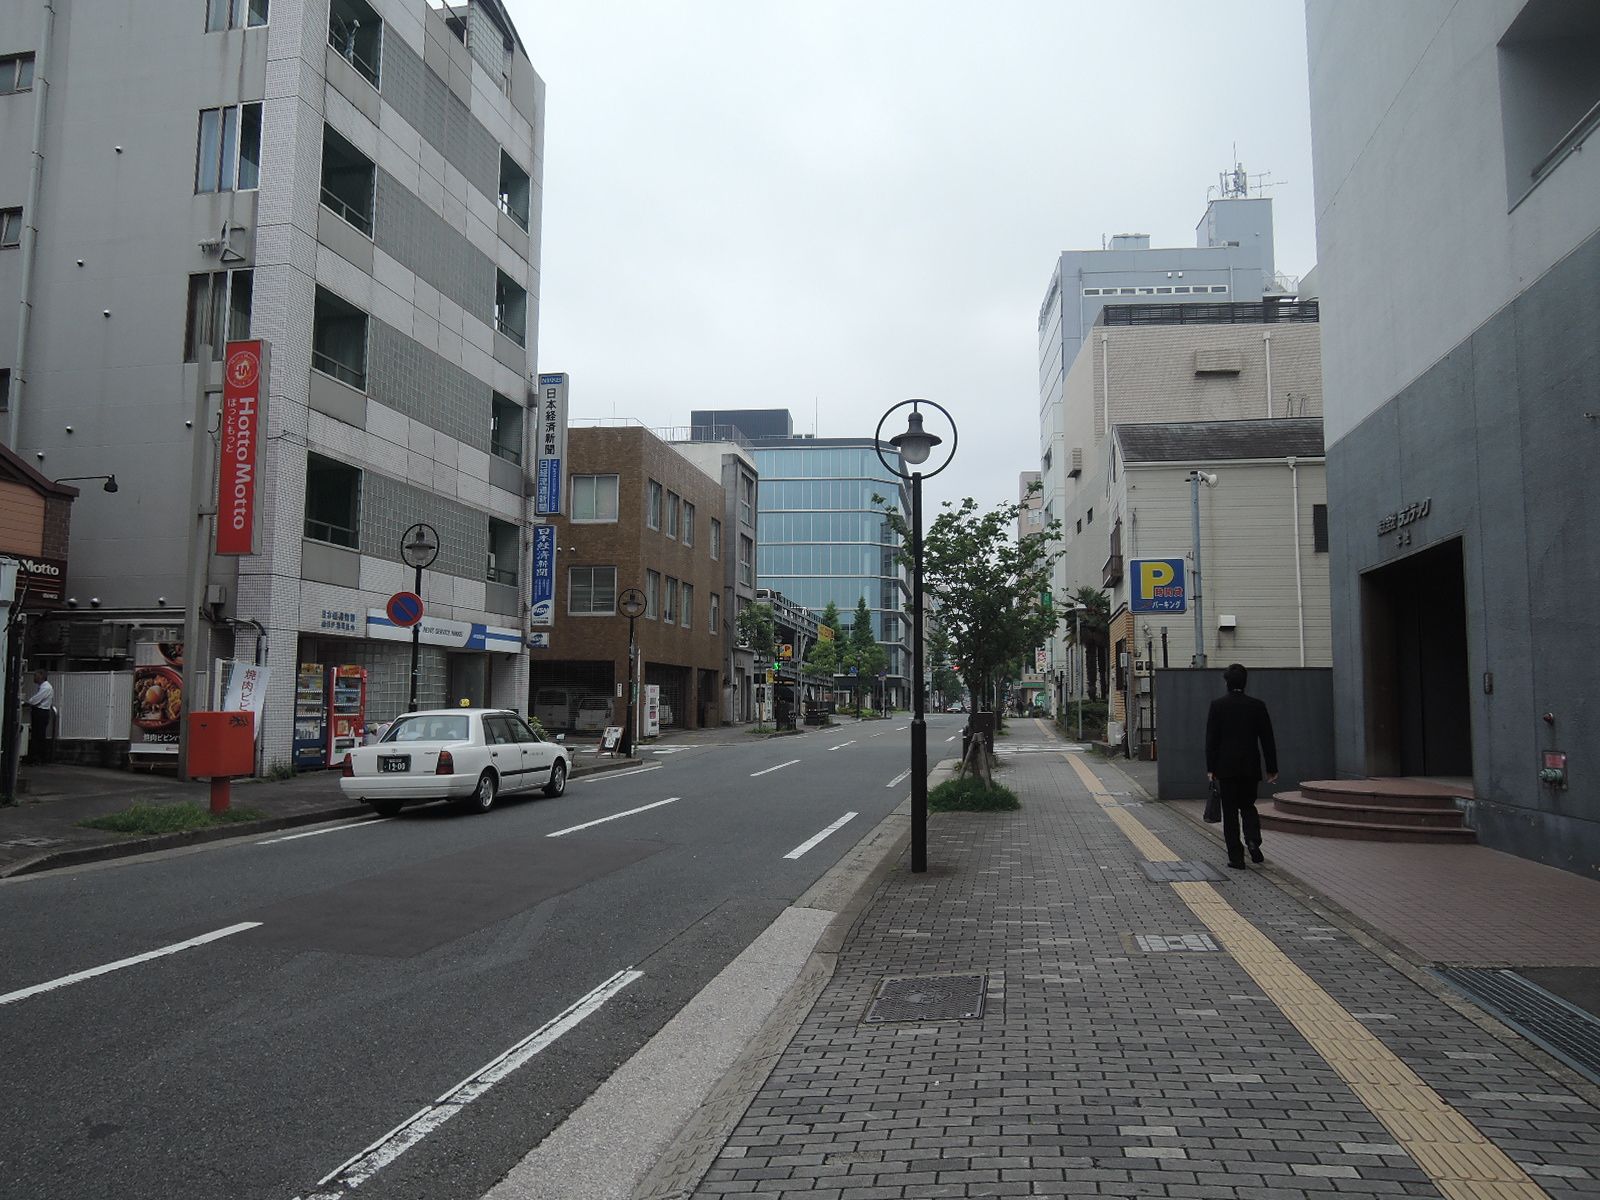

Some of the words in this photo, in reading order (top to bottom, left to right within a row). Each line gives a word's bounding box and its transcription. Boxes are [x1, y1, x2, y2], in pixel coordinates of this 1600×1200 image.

[226, 398, 237, 453] ほっともっと
[236, 398, 254, 461] Hotto
[544, 387, 557, 455] 日本経済新聞
[234, 463, 251, 529] Motto
[20, 559, 60, 576] Motto
[536, 528, 551, 577] 日本経済新聞
[1140, 561, 1174, 599] P
[1151, 600, 1181, 608] パーキング
